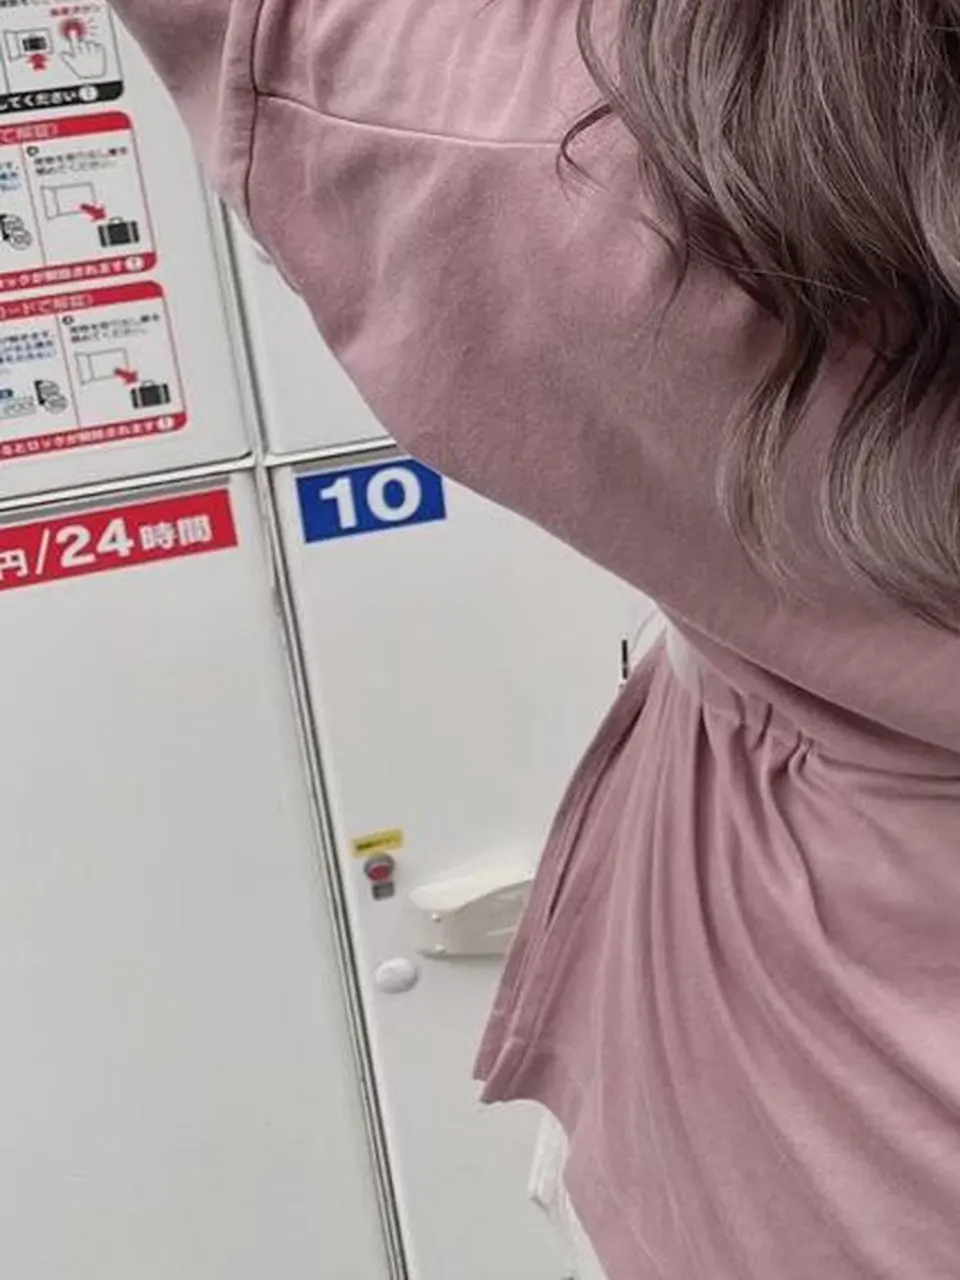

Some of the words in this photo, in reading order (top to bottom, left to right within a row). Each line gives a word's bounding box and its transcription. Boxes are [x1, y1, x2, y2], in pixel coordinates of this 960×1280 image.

[321, 466, 423, 530] 10
[0, 515, 213, 582] 円/24時間
